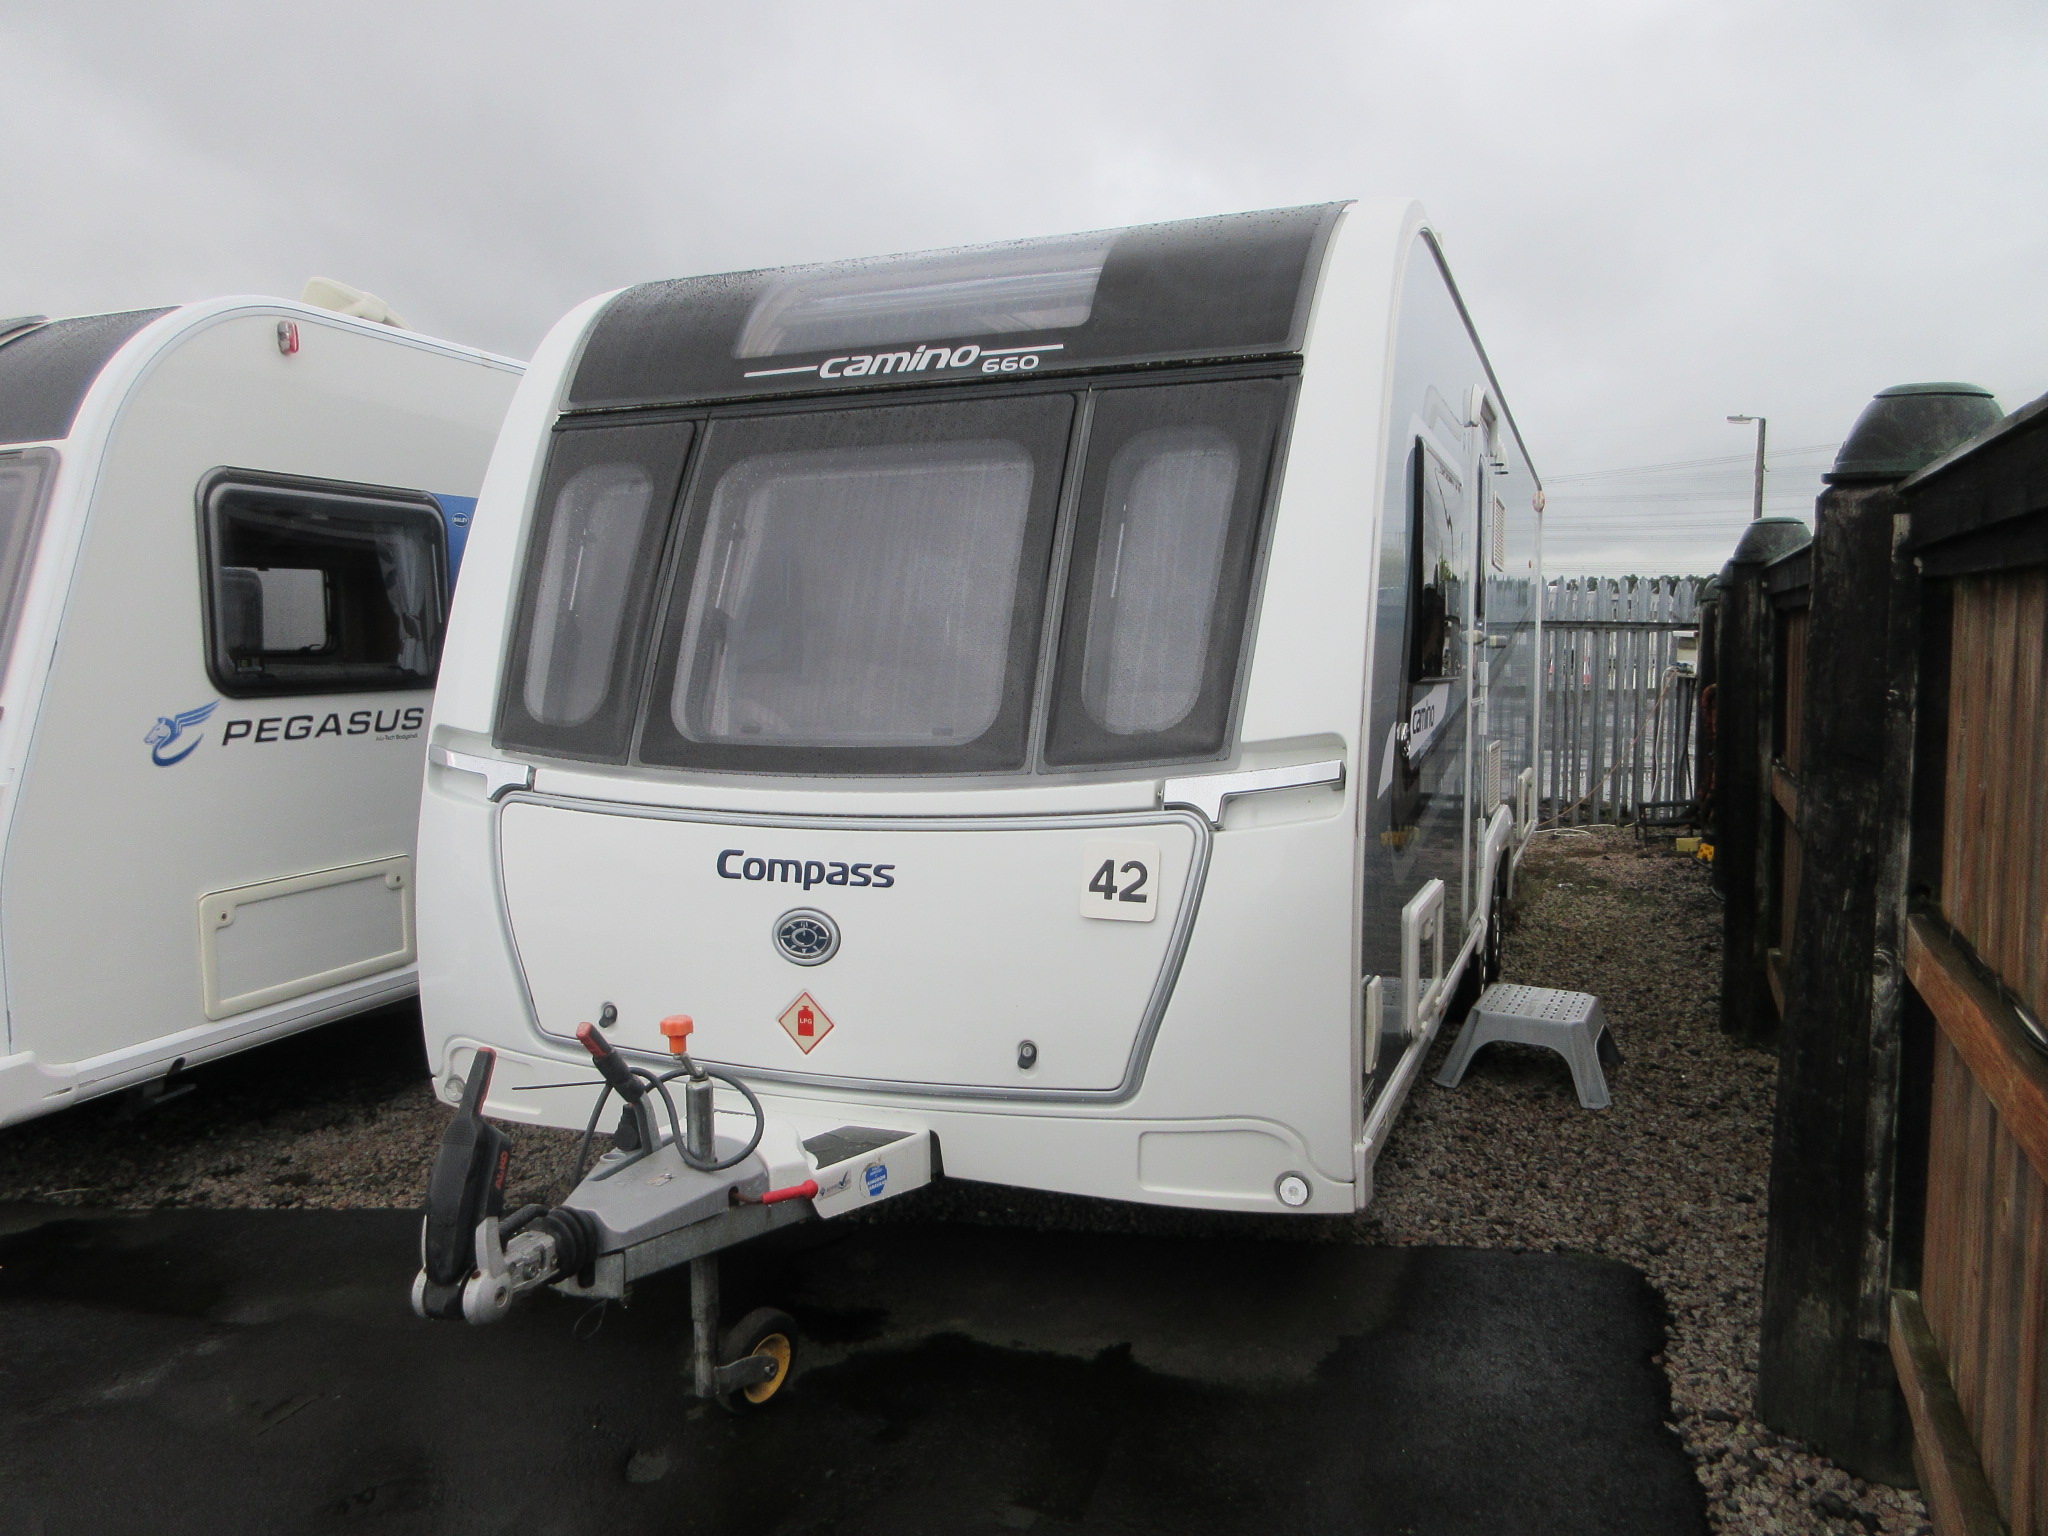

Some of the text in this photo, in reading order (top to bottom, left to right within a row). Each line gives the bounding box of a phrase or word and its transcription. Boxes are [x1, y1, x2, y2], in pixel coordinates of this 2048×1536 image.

[820, 345, 1040, 379] camino 660
[222, 707, 424, 746] PEGASUS
[716, 848, 896, 891] Compass
[1088, 859, 1148, 903] 42
[799, 1017, 813, 1025] LPG
